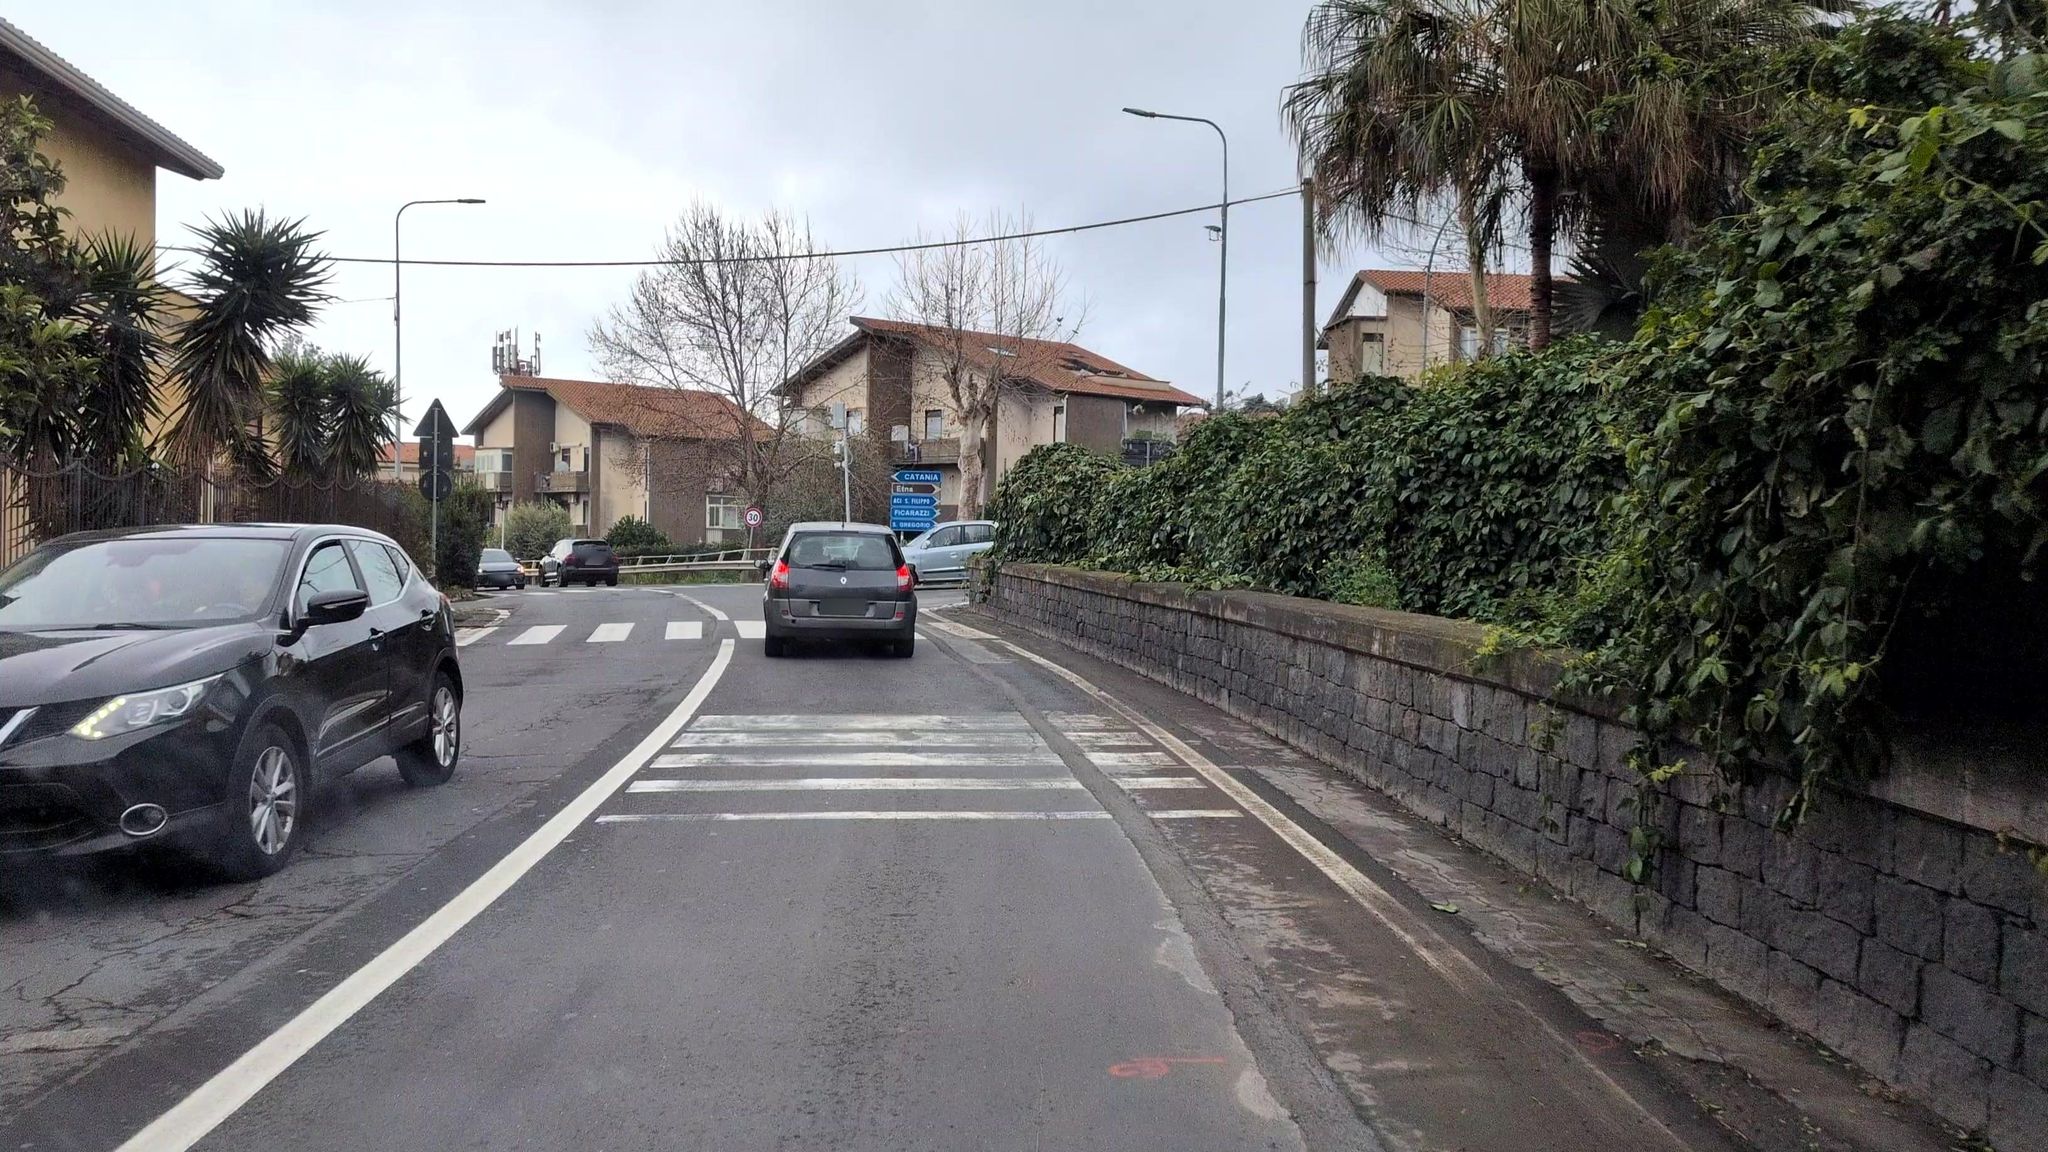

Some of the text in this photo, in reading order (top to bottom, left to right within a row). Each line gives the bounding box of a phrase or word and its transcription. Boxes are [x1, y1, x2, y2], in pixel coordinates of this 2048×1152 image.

[904, 473, 939, 481] CATANIA
[896, 485, 914, 493] Etna
[748, 513, 758, 522] 30
